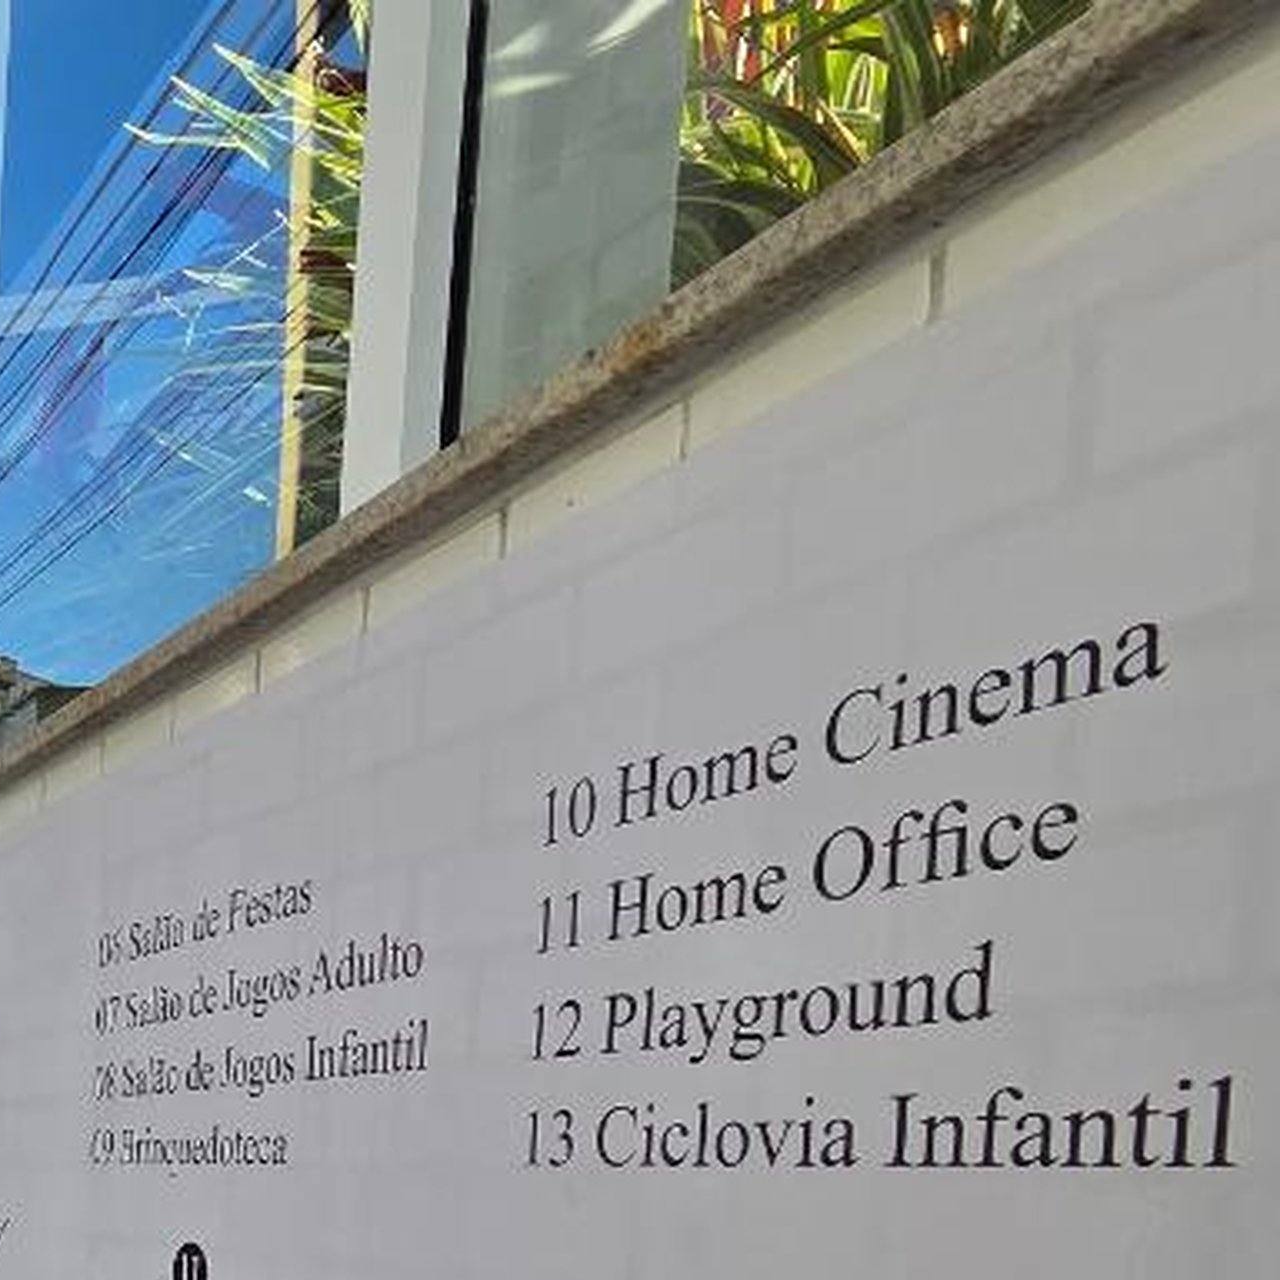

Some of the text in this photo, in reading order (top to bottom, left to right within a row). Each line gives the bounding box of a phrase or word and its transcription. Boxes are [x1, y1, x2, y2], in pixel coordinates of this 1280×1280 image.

[542, 621, 1171, 847] 10 Home Cinema
[128, 914, 184, 961] Salão
[193, 900, 221, 941] de
[227, 880, 312, 933] Festas
[537, 799, 1080, 954] 11 Home Office
[126, 986, 183, 1028] Salão
[190, 976, 218, 1018] de
[223, 966, 302, 1018] Jogos
[309, 933, 424, 996] Adulto
[532, 939, 995, 1065] 12 Playground
[121, 1056, 178, 1098] Salão
[186, 1050, 215, 1091] de
[220, 1047, 295, 1098] Jogos
[304, 1019, 428, 1081] Infantil
[120, 1125, 288, 1178] Brinquedoteca
[525, 1075, 1241, 1169] 13 Ciclovia Infantil
